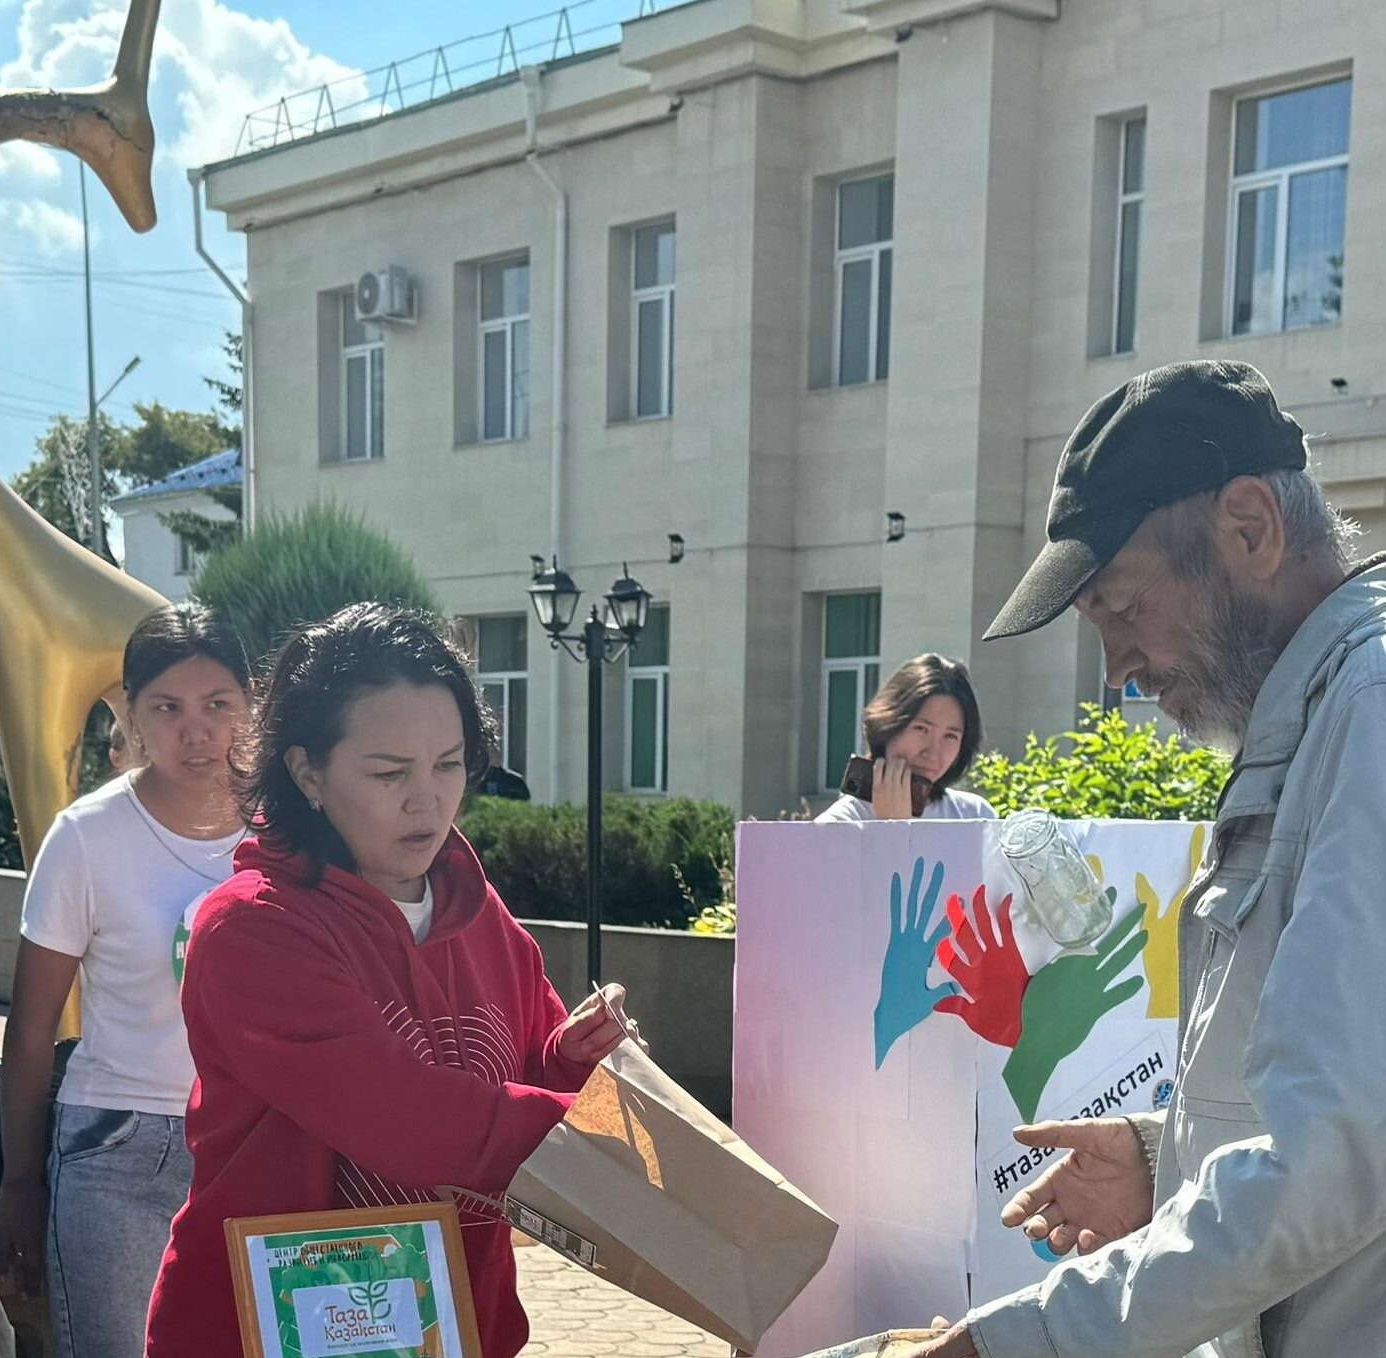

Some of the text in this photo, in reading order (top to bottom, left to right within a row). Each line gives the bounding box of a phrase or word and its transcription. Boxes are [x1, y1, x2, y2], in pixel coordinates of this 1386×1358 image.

[993, 1052, 1164, 1194] #тазазақстан
[325, 1305, 369, 1328] Таза
[324, 1322, 396, 1342] Қазақстан
